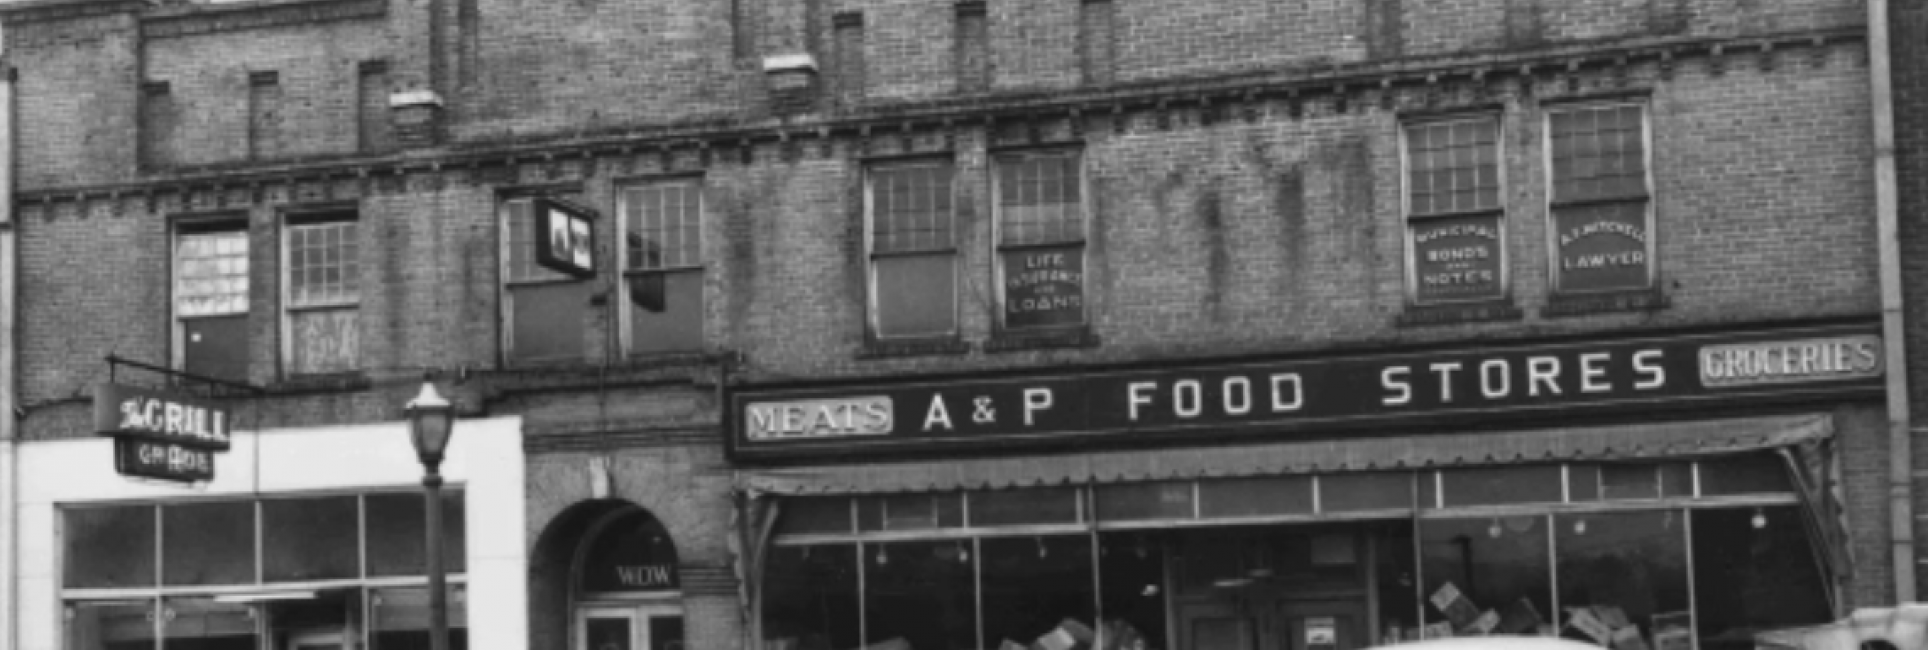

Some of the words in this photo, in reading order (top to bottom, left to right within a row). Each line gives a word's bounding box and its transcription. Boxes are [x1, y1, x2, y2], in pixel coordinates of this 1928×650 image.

[1027, 253, 1065, 269] LIFE
[1426, 246, 1489, 262] BONDS
[1563, 250, 1644, 271] LAWYER
[1423, 270, 1493, 284] NOTES
[1007, 294, 1081, 313] LOANS
[1705, 341, 1876, 380] GROCERIES
[922, 392, 954, 432] A
[971, 396, 997, 424] &
[1022, 387, 1054, 427] P
[1126, 372, 1304, 422] FOOD
[1380, 350, 1666, 405] STORES
[144, 398, 228, 442] GRILL
[750, 402, 889, 438] MEATS
